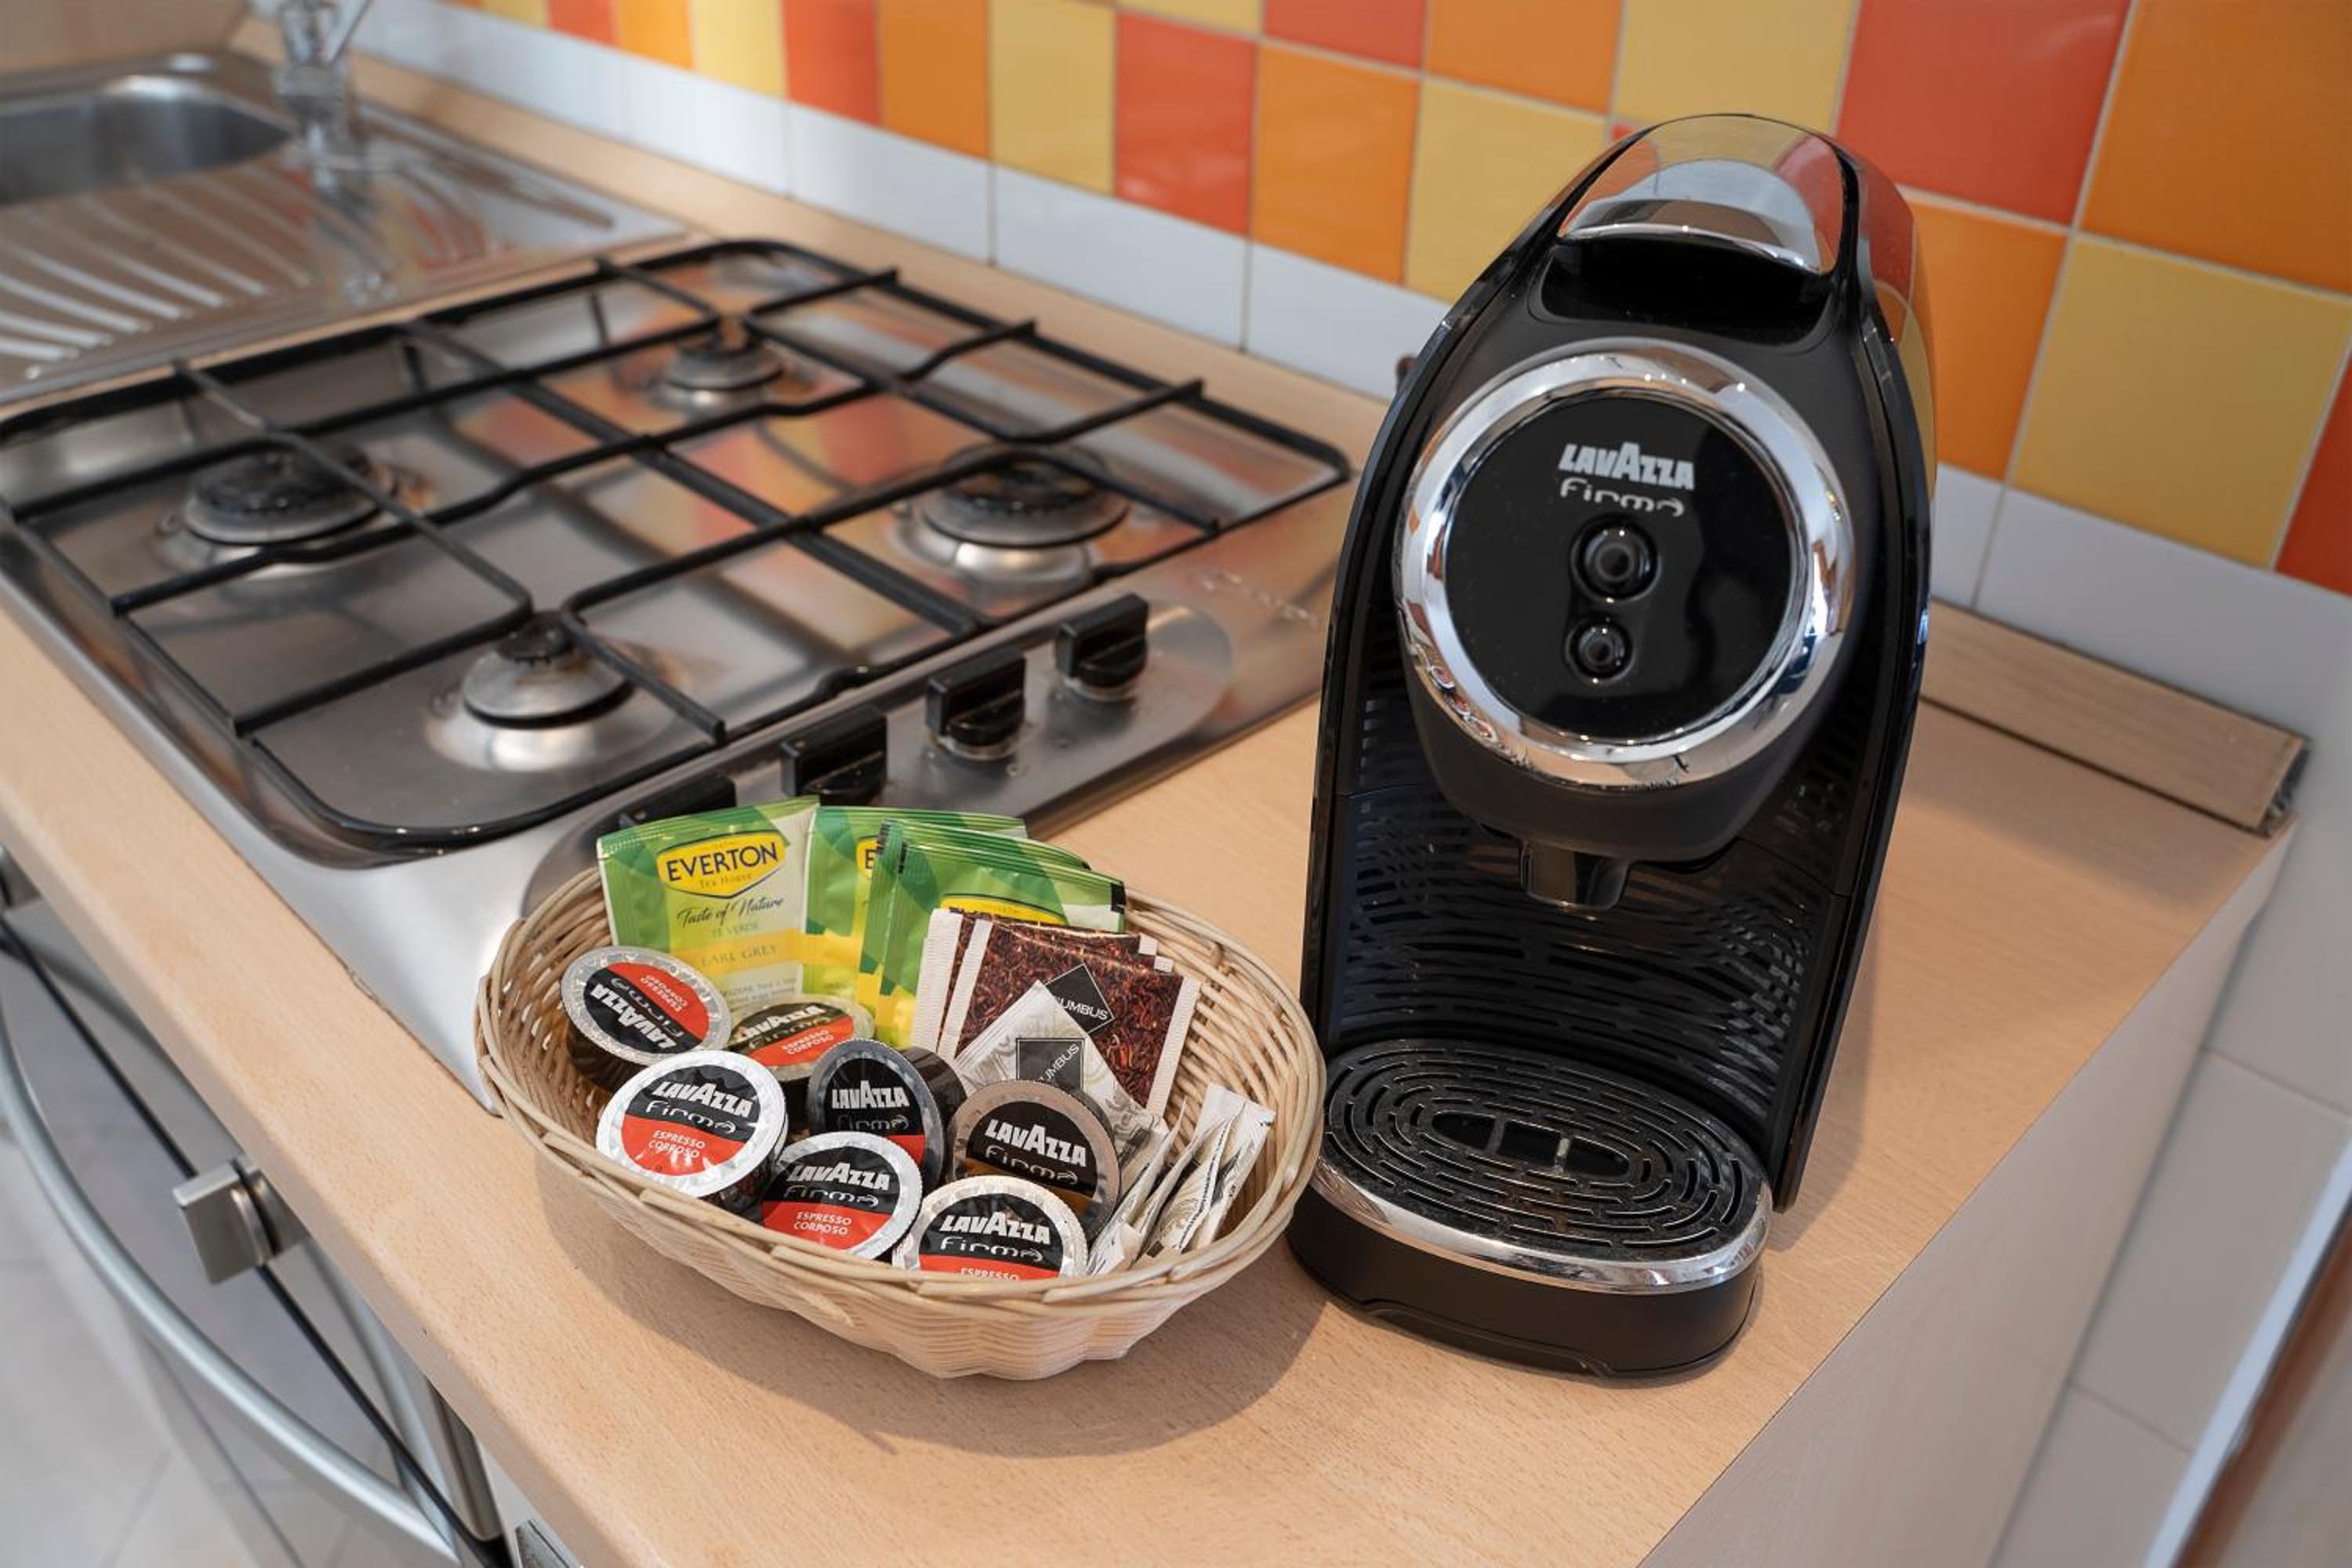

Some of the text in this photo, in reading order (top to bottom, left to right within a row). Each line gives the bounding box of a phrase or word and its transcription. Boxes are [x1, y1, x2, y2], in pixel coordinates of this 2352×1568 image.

[1558, 441, 1694, 491] LAVAZZA
[666, 841, 779, 881] EVERTON
[677, 896, 785, 928] Taste of Nature
[590, 982, 677, 1049] LAVAZZA
[1059, 997, 1109, 1020] UMBUS
[787, 1034, 834, 1054] CORPOSO
[1040, 1044, 1080, 1080] UMBUS
[652, 1081, 753, 1117] LAVAZZA
[832, 1080, 910, 1109] LAVAZZA
[652, 1130, 705, 1149] ESPRESSO
[985, 1119, 1087, 1167] LAVAZZA
[786, 1162, 891, 1191] LAVAZZA
[793, 1221, 848, 1235] CORPOSO
[797, 1211, 851, 1225] ESPRESSO
[939, 1211, 1051, 1245] LAVAZZA
[960, 1267, 1019, 1280] ESPRESSO
